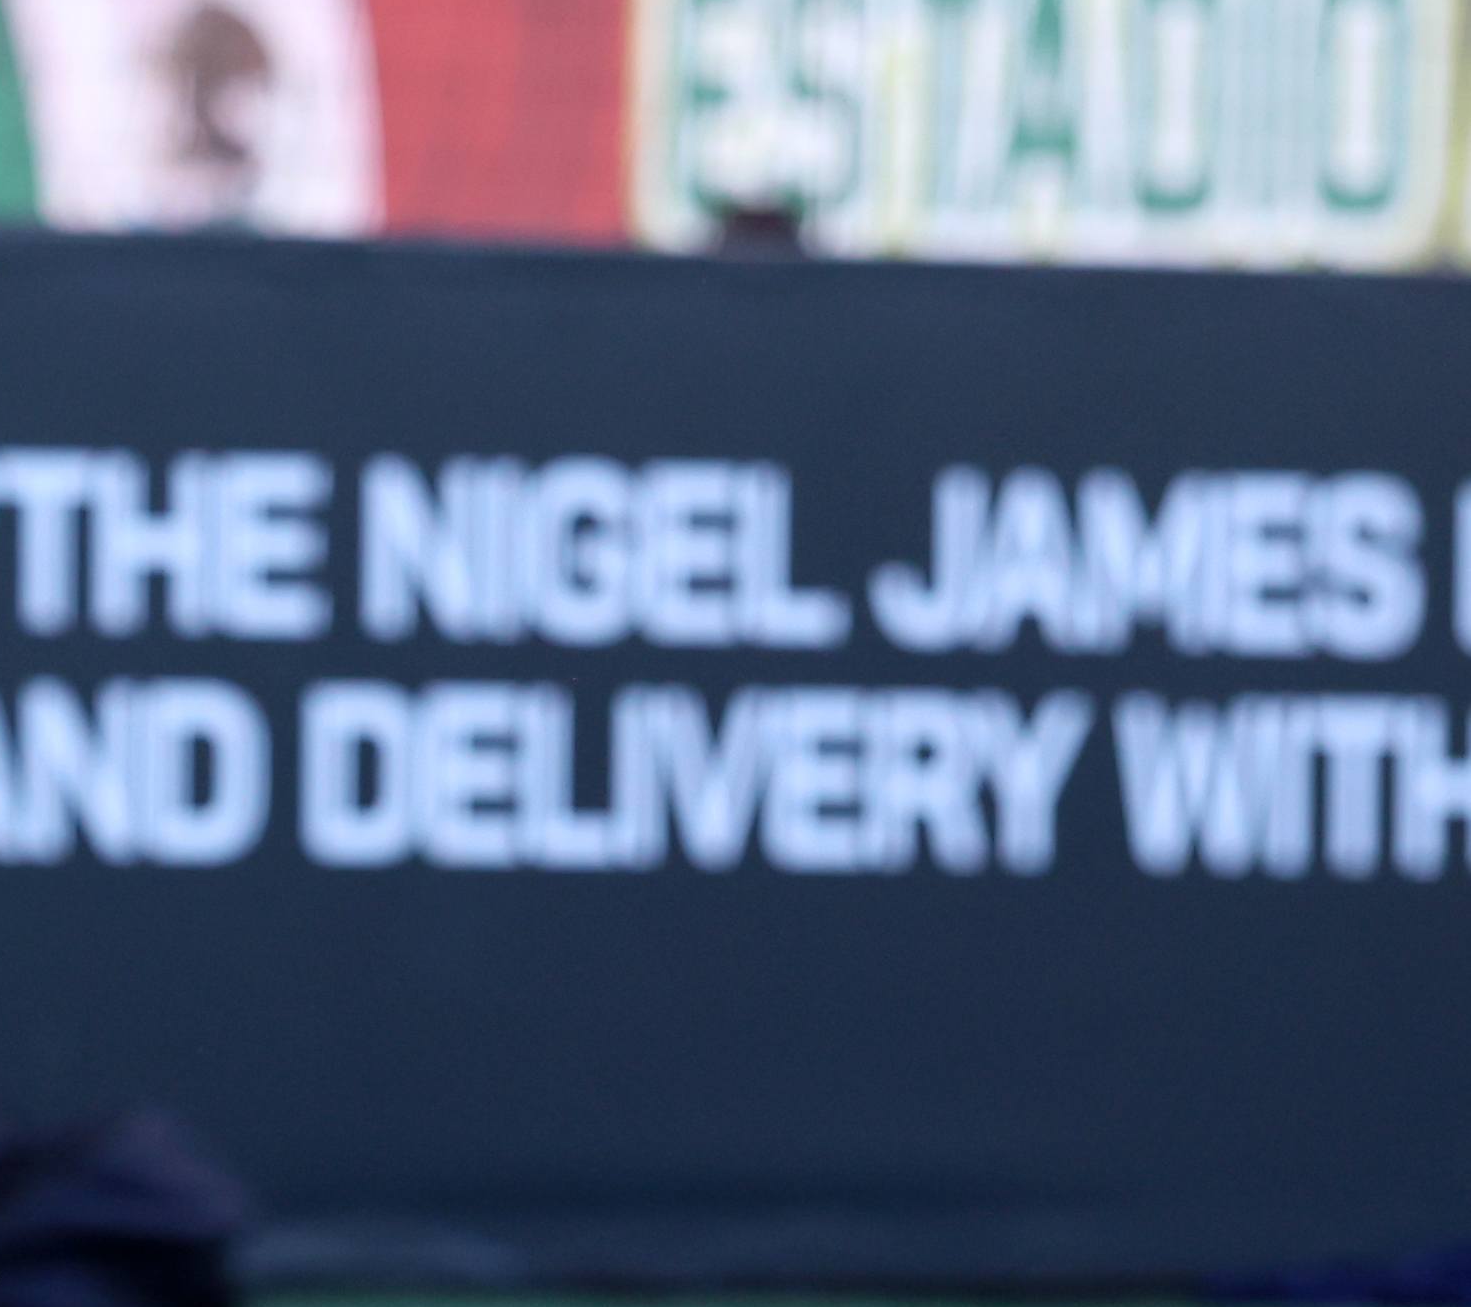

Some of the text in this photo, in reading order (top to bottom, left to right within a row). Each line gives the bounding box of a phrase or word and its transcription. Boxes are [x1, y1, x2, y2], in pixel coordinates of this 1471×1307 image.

[358, 451, 852, 650] NIGEL
[866, 463, 1426, 662] JAMES
[294, 676, 1094, 878] DELIVERY
[1110, 690, 1471, 884] WITH
